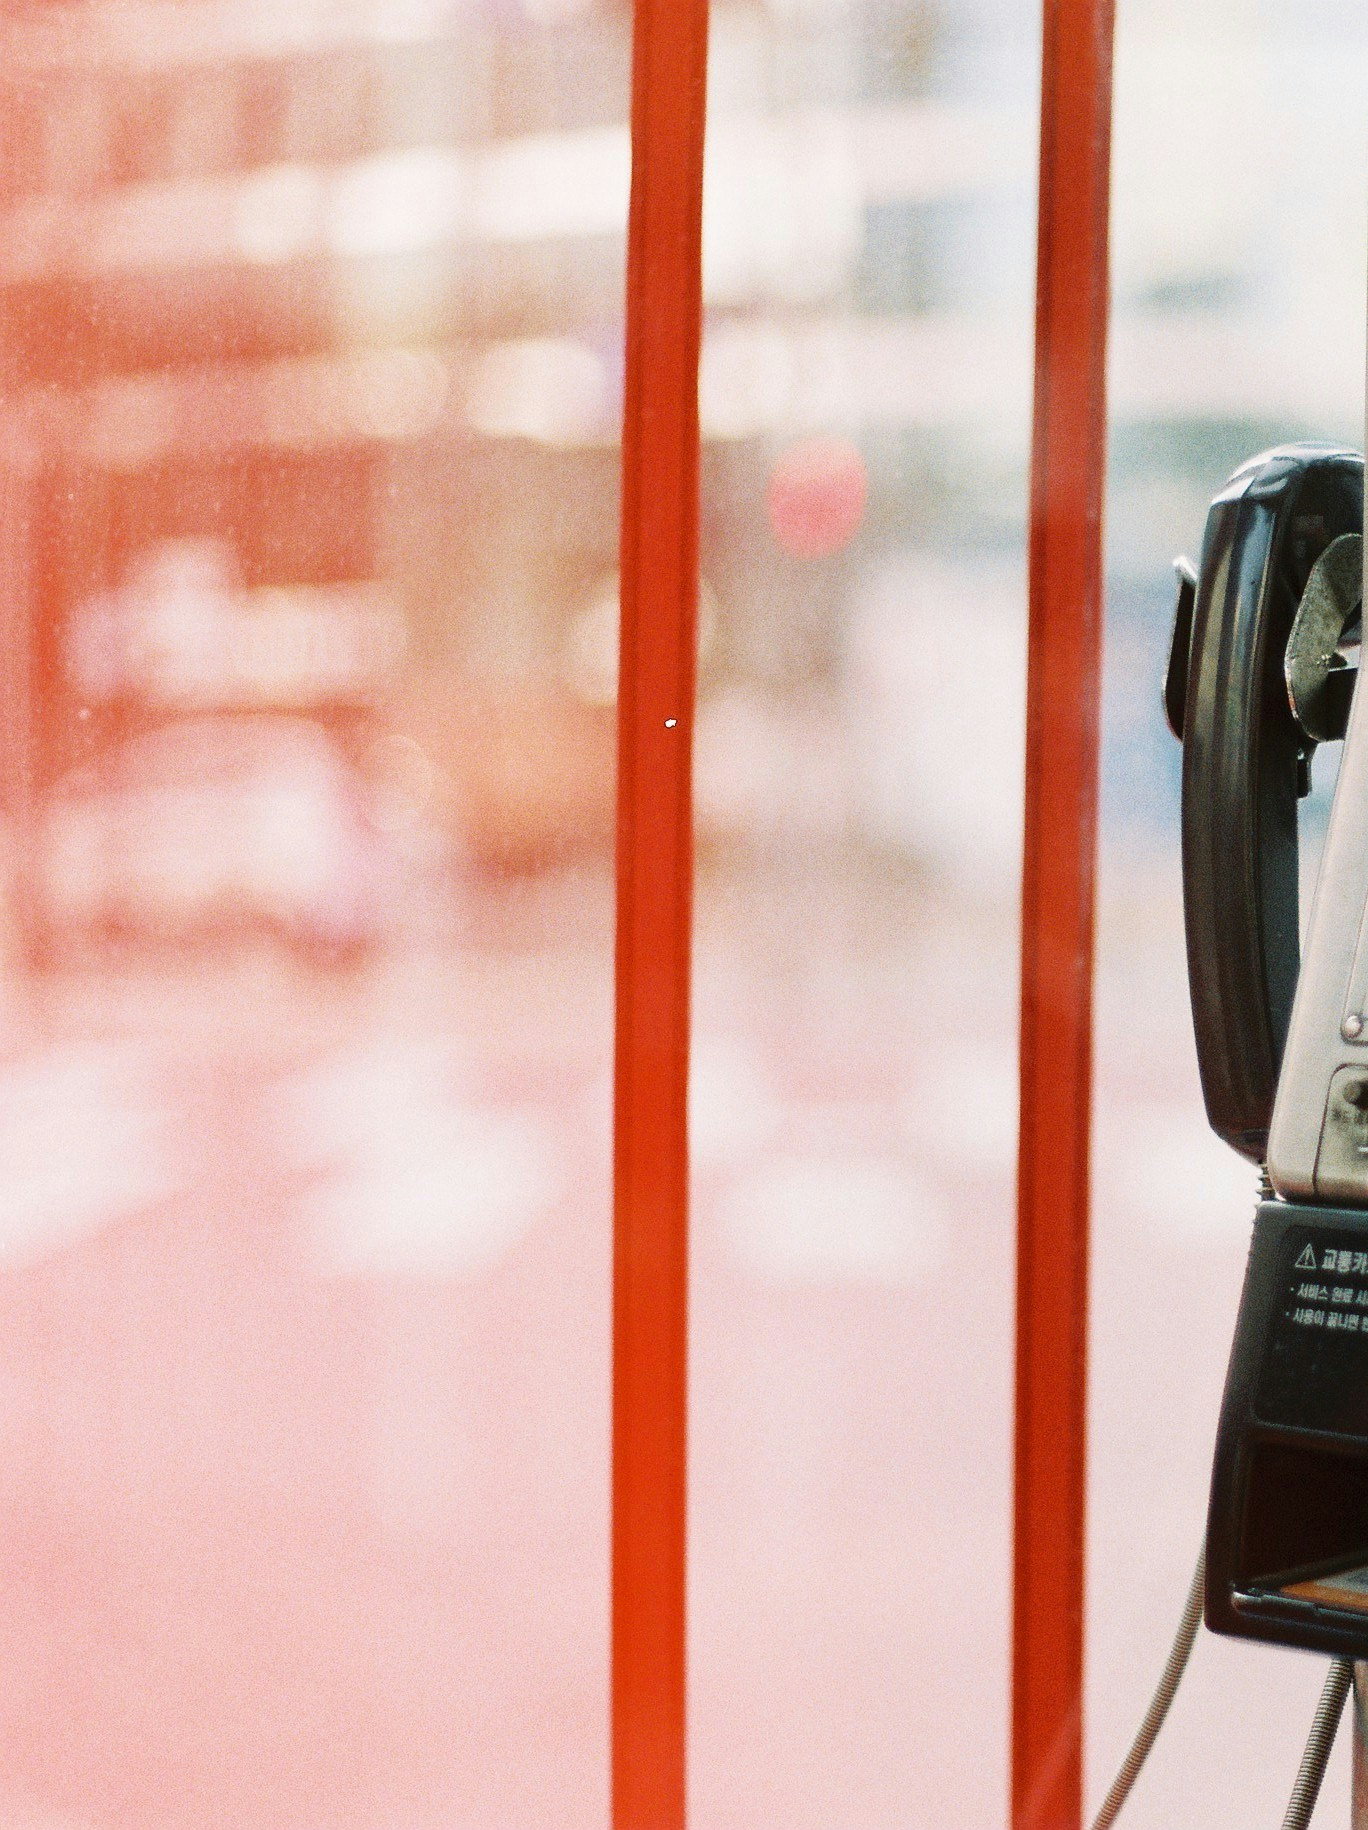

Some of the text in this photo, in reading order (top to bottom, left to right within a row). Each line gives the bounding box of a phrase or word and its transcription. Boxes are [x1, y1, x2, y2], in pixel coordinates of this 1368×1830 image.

[1297, 1282, 1329, 1301] 서비스
[1292, 1307, 1326, 1326] 사용이
[1326, 1311, 1361, 1331] 끝나면
